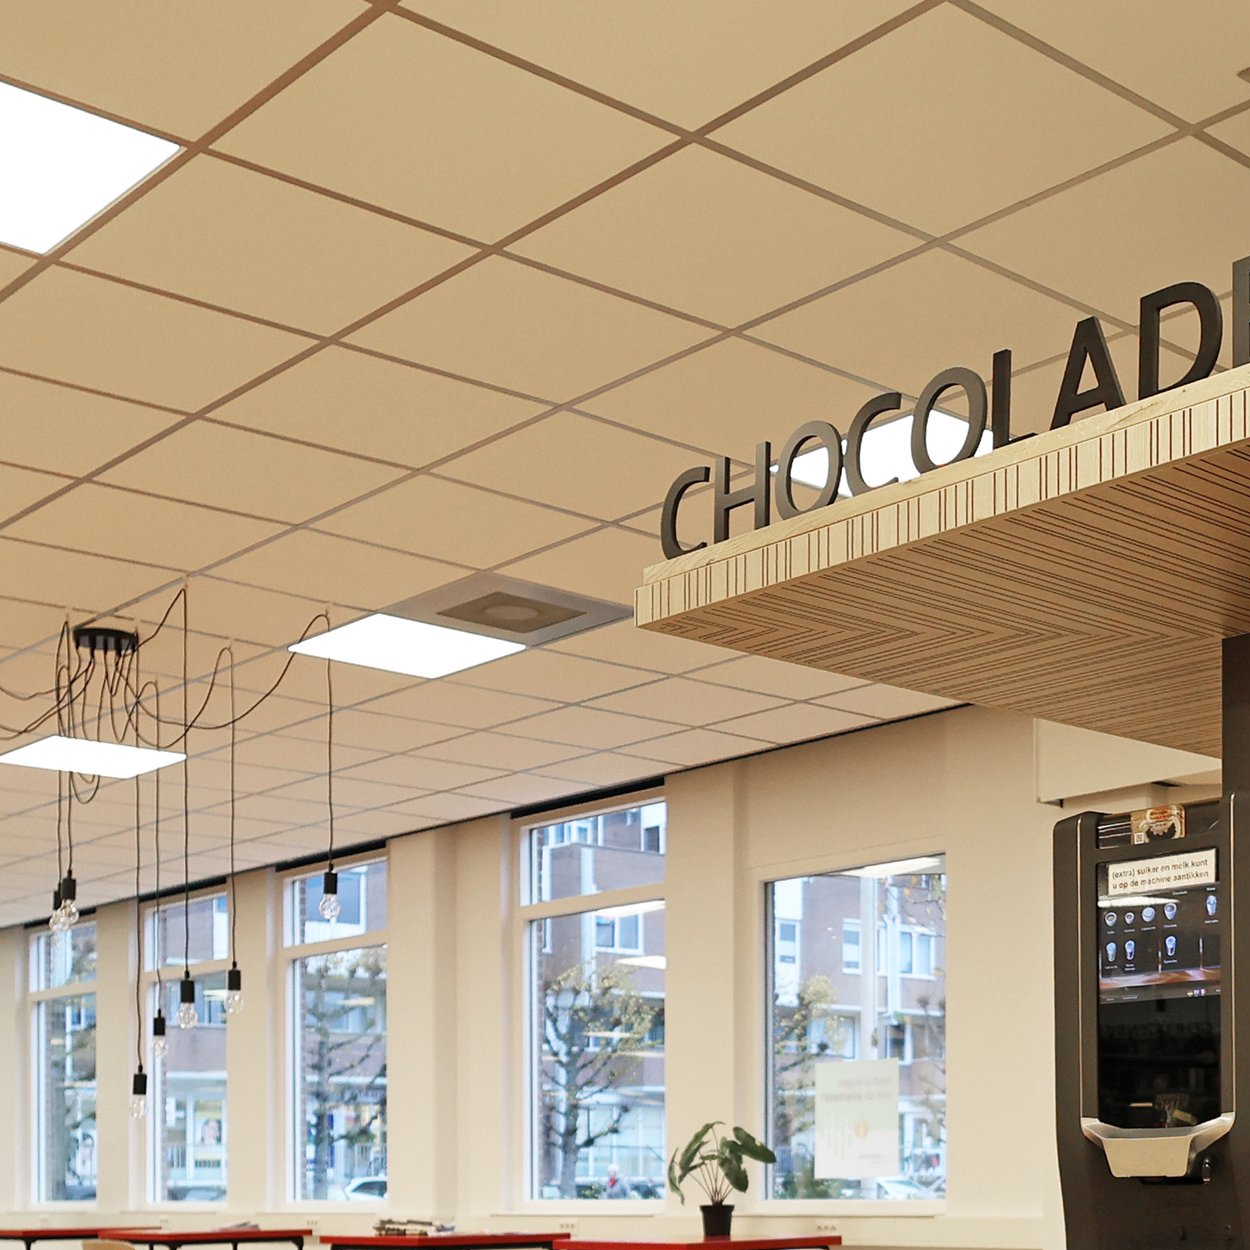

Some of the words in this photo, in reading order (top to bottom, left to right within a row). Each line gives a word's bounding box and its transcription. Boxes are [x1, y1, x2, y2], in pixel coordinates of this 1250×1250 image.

[1137, 866, 1158, 875] suiker
[1160, 864, 1170, 872] en
[1171, 861, 1189, 871] melk
[1191, 859, 1208, 868] kunt
[1119, 881, 1128, 889] op
[1130, 879, 1139, 887] de
[1141, 875, 1171, 885] machine
[1173, 871, 1209, 882] aantikken
